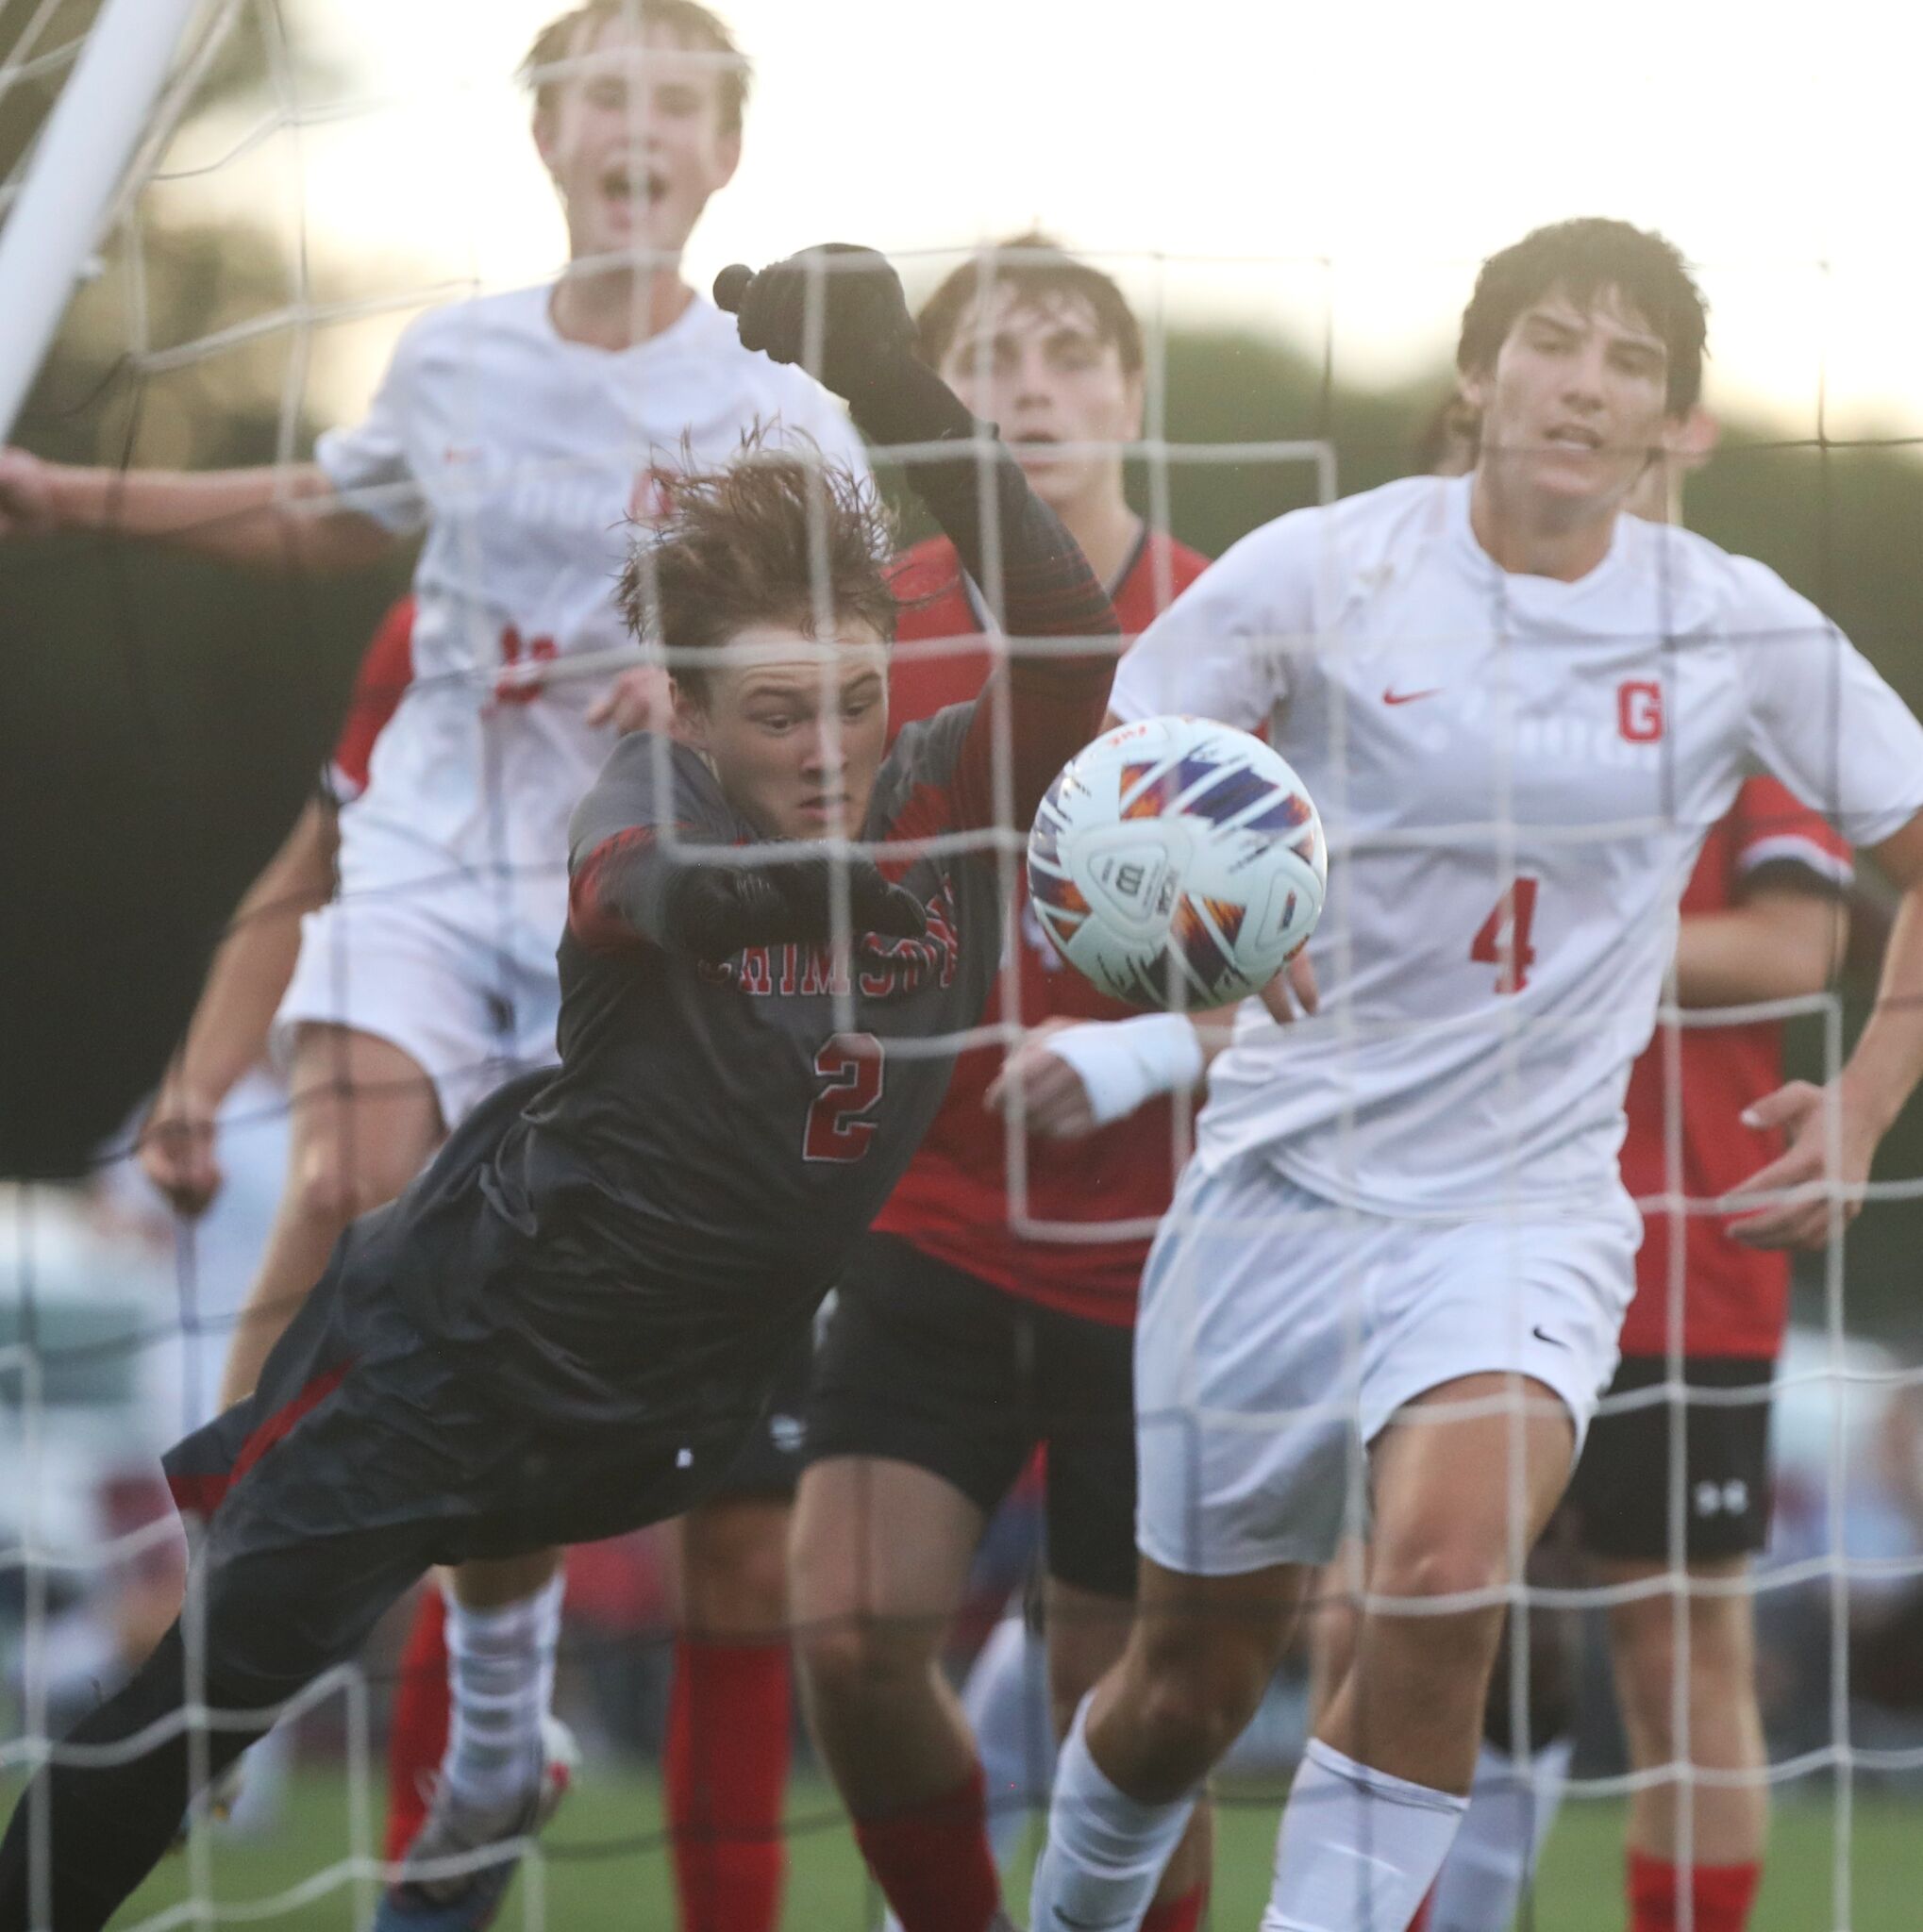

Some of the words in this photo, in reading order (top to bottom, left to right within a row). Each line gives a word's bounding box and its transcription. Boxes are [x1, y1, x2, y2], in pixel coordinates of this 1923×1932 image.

[1616, 679, 1664, 744] G
[1468, 876, 1538, 994] 4
[802, 1032, 885, 1162] 2
